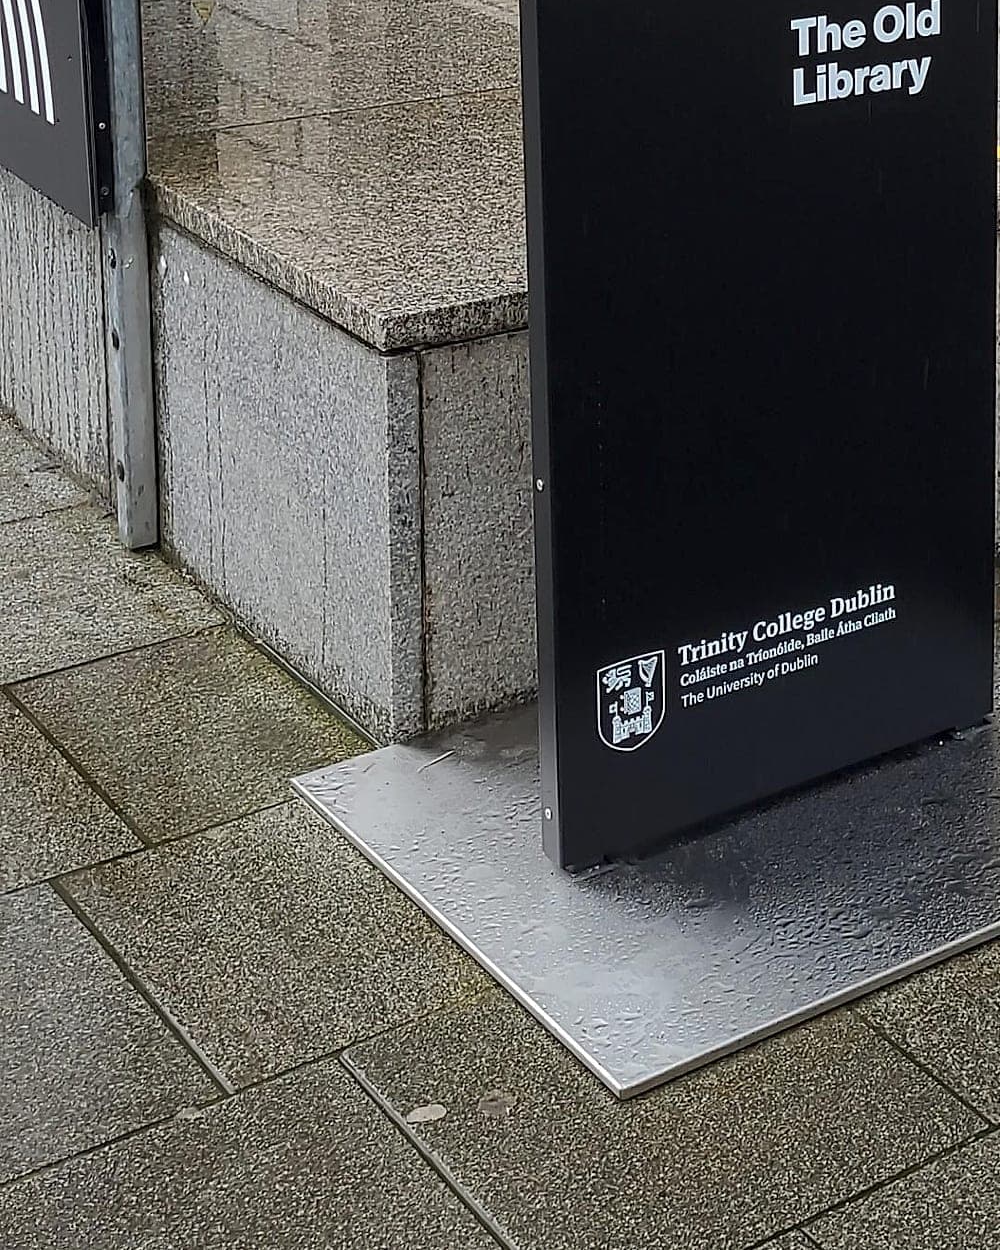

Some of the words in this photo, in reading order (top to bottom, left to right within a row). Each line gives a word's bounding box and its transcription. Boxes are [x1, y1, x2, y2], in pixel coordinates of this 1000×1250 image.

[791, 15, 866, 56] The
[793, 57, 931, 107] Library
[678, 631, 748, 666] Trinity
[753, 607, 826, 642] College
[830, 584, 896, 618] Dublin
[680, 664, 727, 687] Coláiste
[729, 658, 745, 671] na
[836, 620, 863, 637] Átha
[681, 692, 704, 707] The
[706, 671, 765, 699] University
[767, 663, 780, 679] of
[781, 654, 818, 675] Dublin
